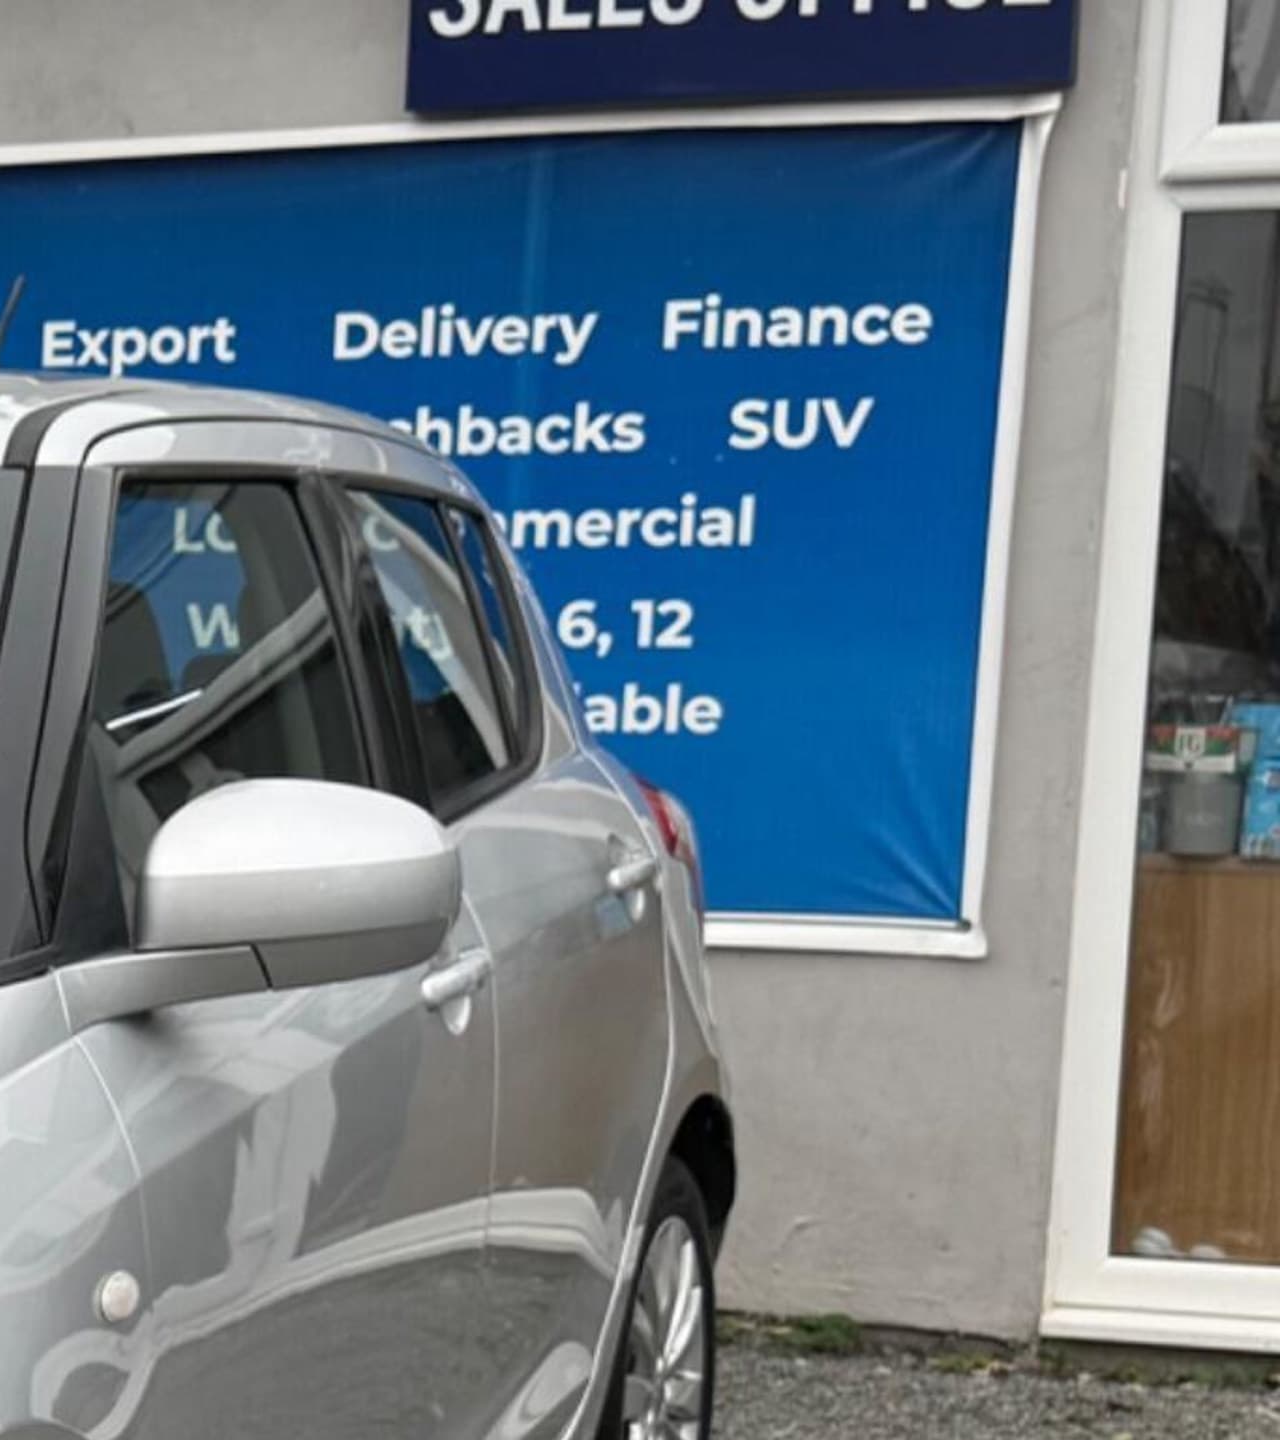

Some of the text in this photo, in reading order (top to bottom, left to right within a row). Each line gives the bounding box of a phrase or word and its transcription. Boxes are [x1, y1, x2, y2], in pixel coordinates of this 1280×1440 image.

[42, 292, 933, 376] Export Delivery Finance
[728, 397, 874, 450] SUV
[557, 599, 694, 659] 6, 12
